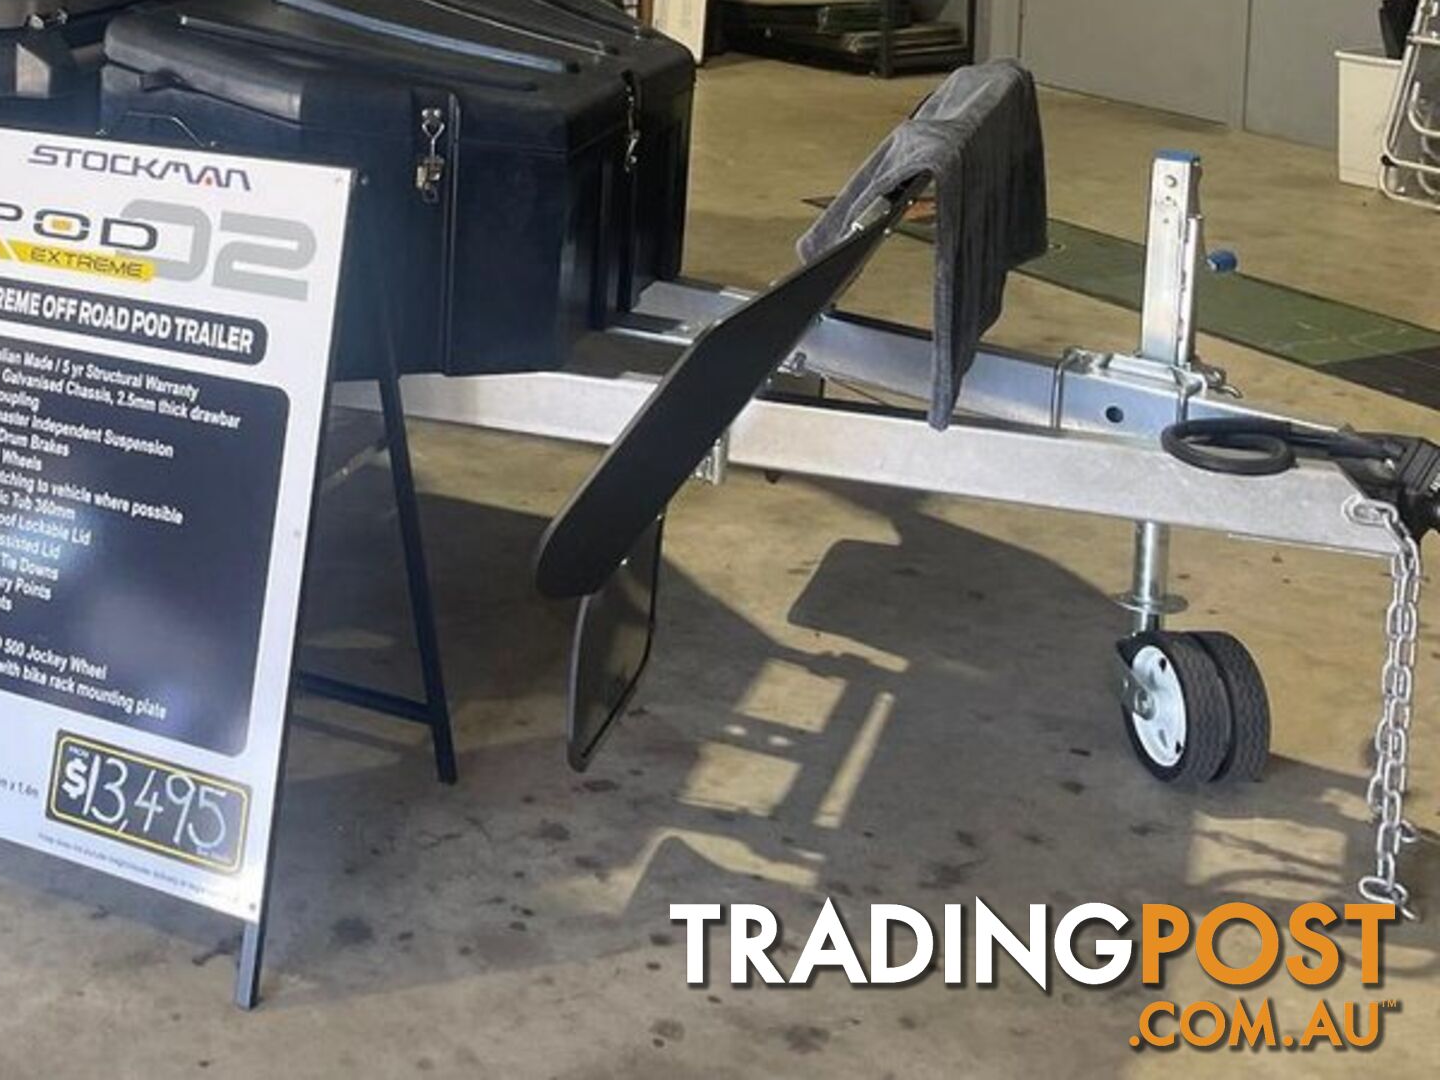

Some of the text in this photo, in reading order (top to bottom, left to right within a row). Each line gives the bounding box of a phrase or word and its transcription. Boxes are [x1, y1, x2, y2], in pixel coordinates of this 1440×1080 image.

[28, 145, 252, 191] STOCKMAN
[29, 247, 145, 278] EXTREME
[42, 295, 78, 321] OFF
[79, 303, 130, 333] ROAD
[131, 309, 171, 340] POD
[173, 317, 254, 355] TRAILER
[23, 352, 54, 371] Made
[85, 364, 142, 389] Structural
[146, 374, 199, 402] Warranty
[2, 367, 64, 393] Galvanised
[116, 390, 156, 412] 2.5mm
[157, 399, 188, 418] thick
[189, 405, 240, 428] drawbar
[30, 434, 69, 457] Brakes
[31, 414, 101, 442] Independent
[103, 428, 173, 458] Suspension
[2, 448, 42, 471] Wheels
[37, 479, 49, 493] to
[51, 483, 92, 504] vehicle
[93, 491, 130, 513] where
[131, 502, 183, 524] possible
[18, 514, 69, 540] Lockable
[71, 527, 92, 546] Lid
[41, 540, 60, 559] Lid
[20, 557, 59, 580] Downs
[14, 577, 51, 600] Points
[26, 645, 67, 672] Jockey
[69, 655, 107, 680] Wheel
[22, 664, 47, 685] bike
[49, 676, 75, 693] rack
[76, 683, 134, 713] mounting
[135, 698, 166, 720] plate
